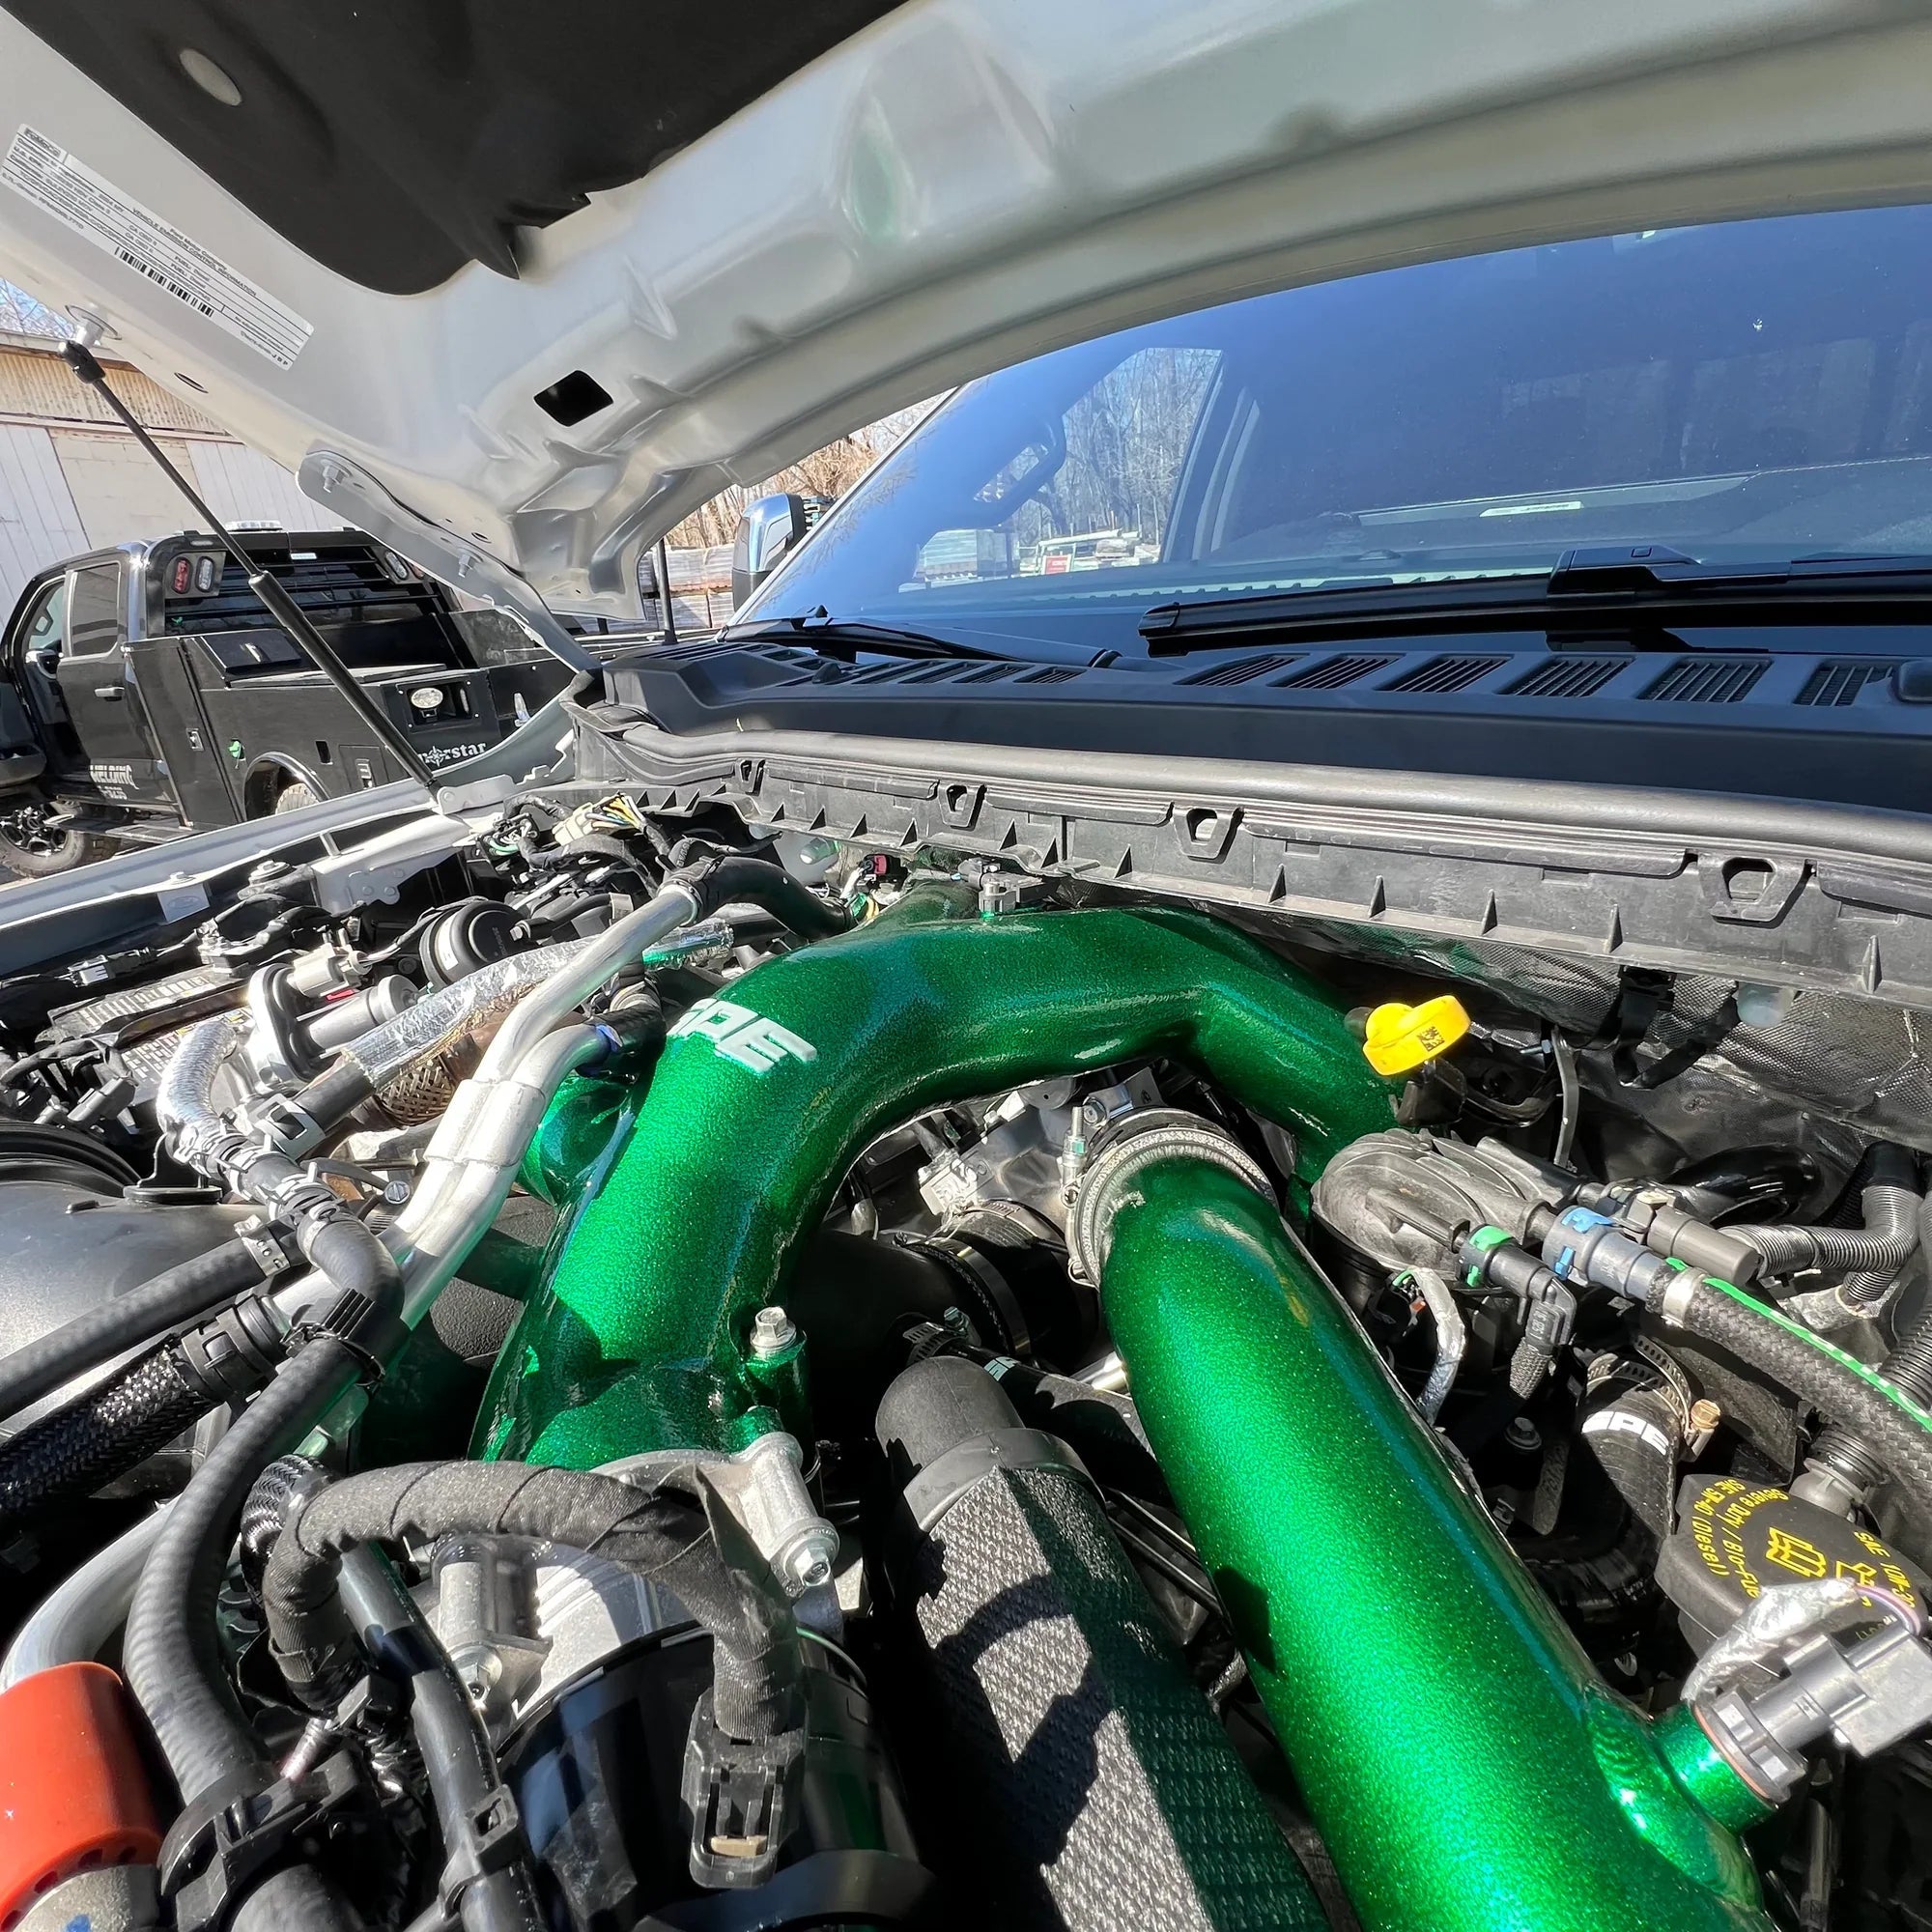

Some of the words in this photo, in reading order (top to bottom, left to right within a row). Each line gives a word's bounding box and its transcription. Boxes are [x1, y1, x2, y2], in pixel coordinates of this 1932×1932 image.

[132, 208, 157, 228] VEHICLE
[159, 226, 188, 249] EMISSION
[188, 247, 217, 269] CONTROL
[217, 267, 256, 296] INFORMATION
[169, 227, 184, 240] Ford
[184, 238, 201, 251] Motor
[201, 249, 227, 270] Company
[90, 764, 140, 790] WELDING
[1714, 1478, 1746, 1495] SAE
[1739, 1488, 1790, 1508] Severe
[1716, 1502, 1751, 1529] Duty
[1691, 1516, 1730, 1577] (Diesel)
[1853, 1530, 1891, 1558] SAE
[1722, 1540, 1762, 1599] Bio-Fue
